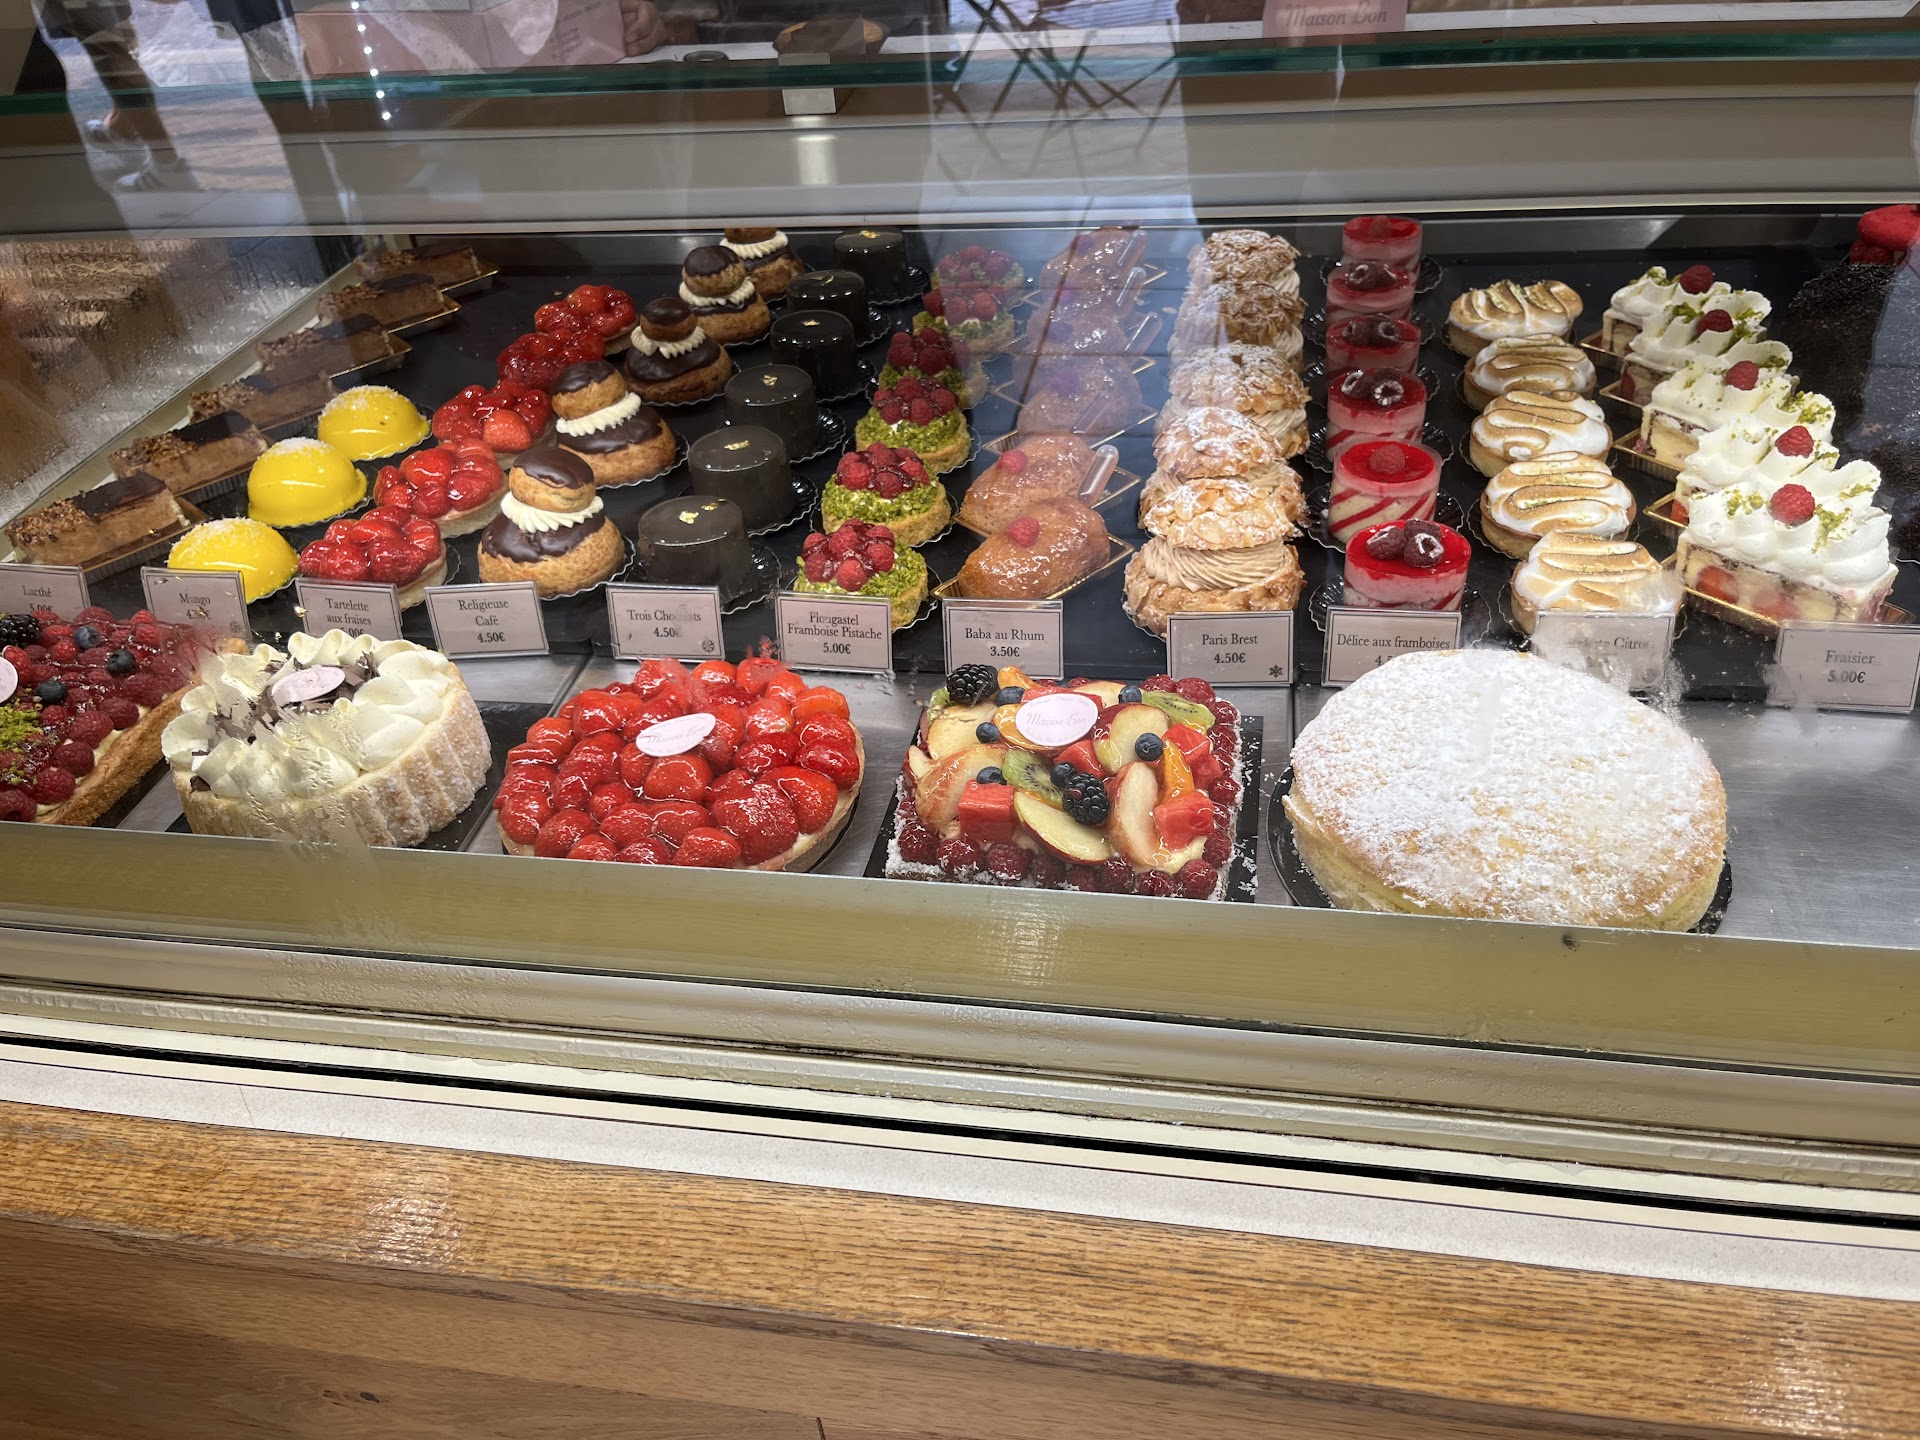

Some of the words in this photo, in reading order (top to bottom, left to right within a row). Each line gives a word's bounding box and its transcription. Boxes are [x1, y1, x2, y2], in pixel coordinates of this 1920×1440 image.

[1285, 5, 1346, 27] Maison
[22, 585, 52, 598] Lacthé
[179, 593, 211, 607] Mango
[325, 597, 369, 612] Tartelette
[458, 599, 509, 612] Religieuse
[327, 614, 343, 624] aux
[344, 613, 372, 626] fraises
[475, 614, 499, 626] Café
[627, 609, 652, 621] Trois
[477, 631, 506, 643] 4.50€
[787, 622, 839, 637] Framboise
[842, 626, 882, 640] Pistache
[965, 627, 991, 639] Baba
[994, 632, 1008, 640] au
[1011, 629, 1044, 641] Rhum
[1201, 633, 1228, 646] Paris
[1231, 633, 1258, 645] Brest
[1337, 633, 1370, 647] Délice
[1372, 639, 1392, 648] aux
[1394, 636, 1450, 649] framboises
[823, 642, 851, 654] 5.00€
[990, 646, 1020, 657] 3.50€
[1214, 652, 1246, 664] 4.50€
[1825, 649, 1876, 664] Fraisier
[1026, 711, 1064, 727] Maison
[1067, 711, 1087, 727] Bon
